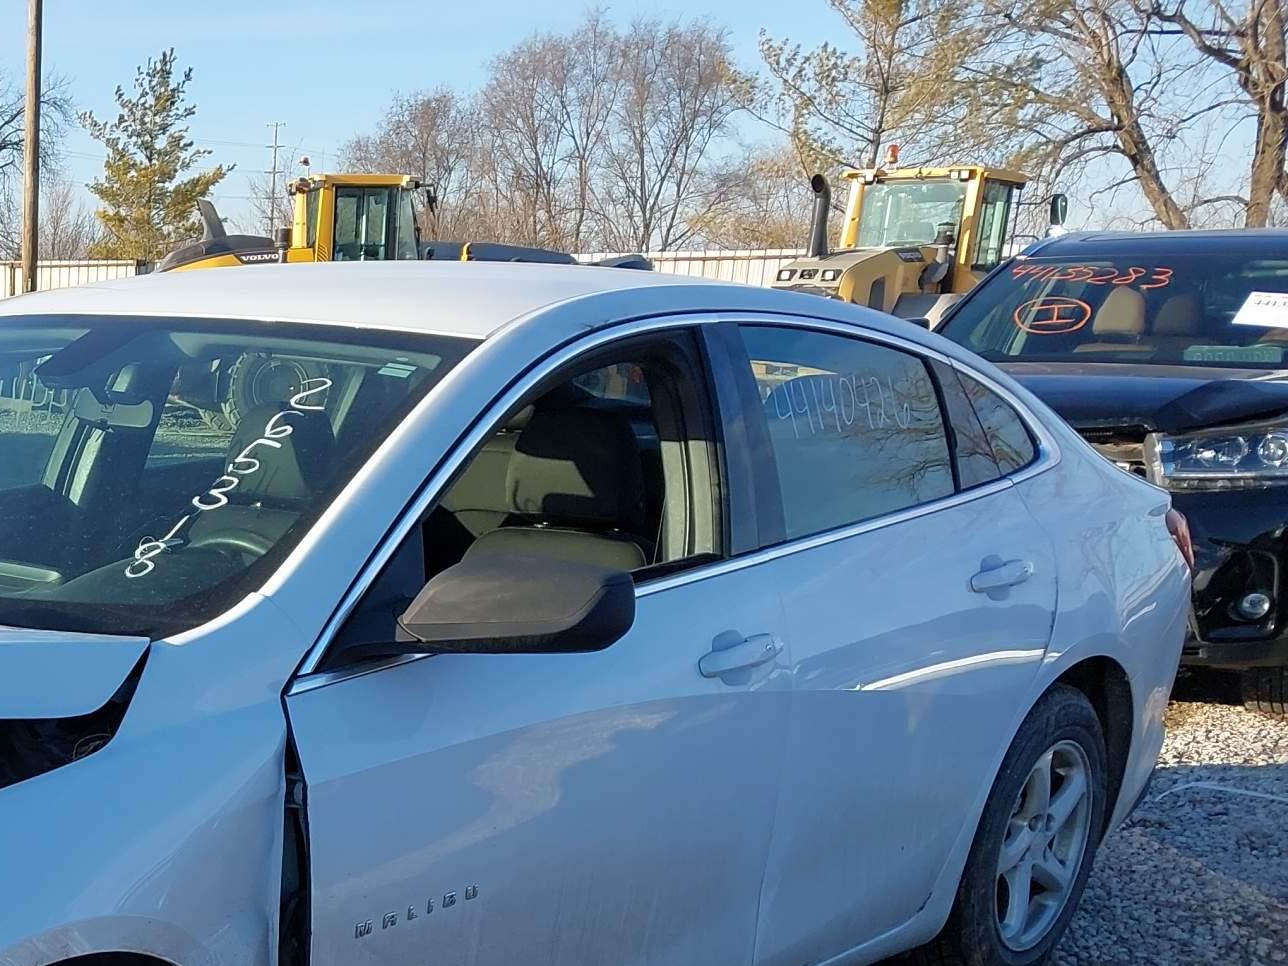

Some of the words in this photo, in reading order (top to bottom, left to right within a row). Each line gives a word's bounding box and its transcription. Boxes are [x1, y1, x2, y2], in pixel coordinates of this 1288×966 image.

[240, 253, 279, 262] VOLVO
[1013, 264, 1173, 289] 44135283
[774, 375, 910, 439] 44140426
[355, 883, 480, 938] MALIBU
